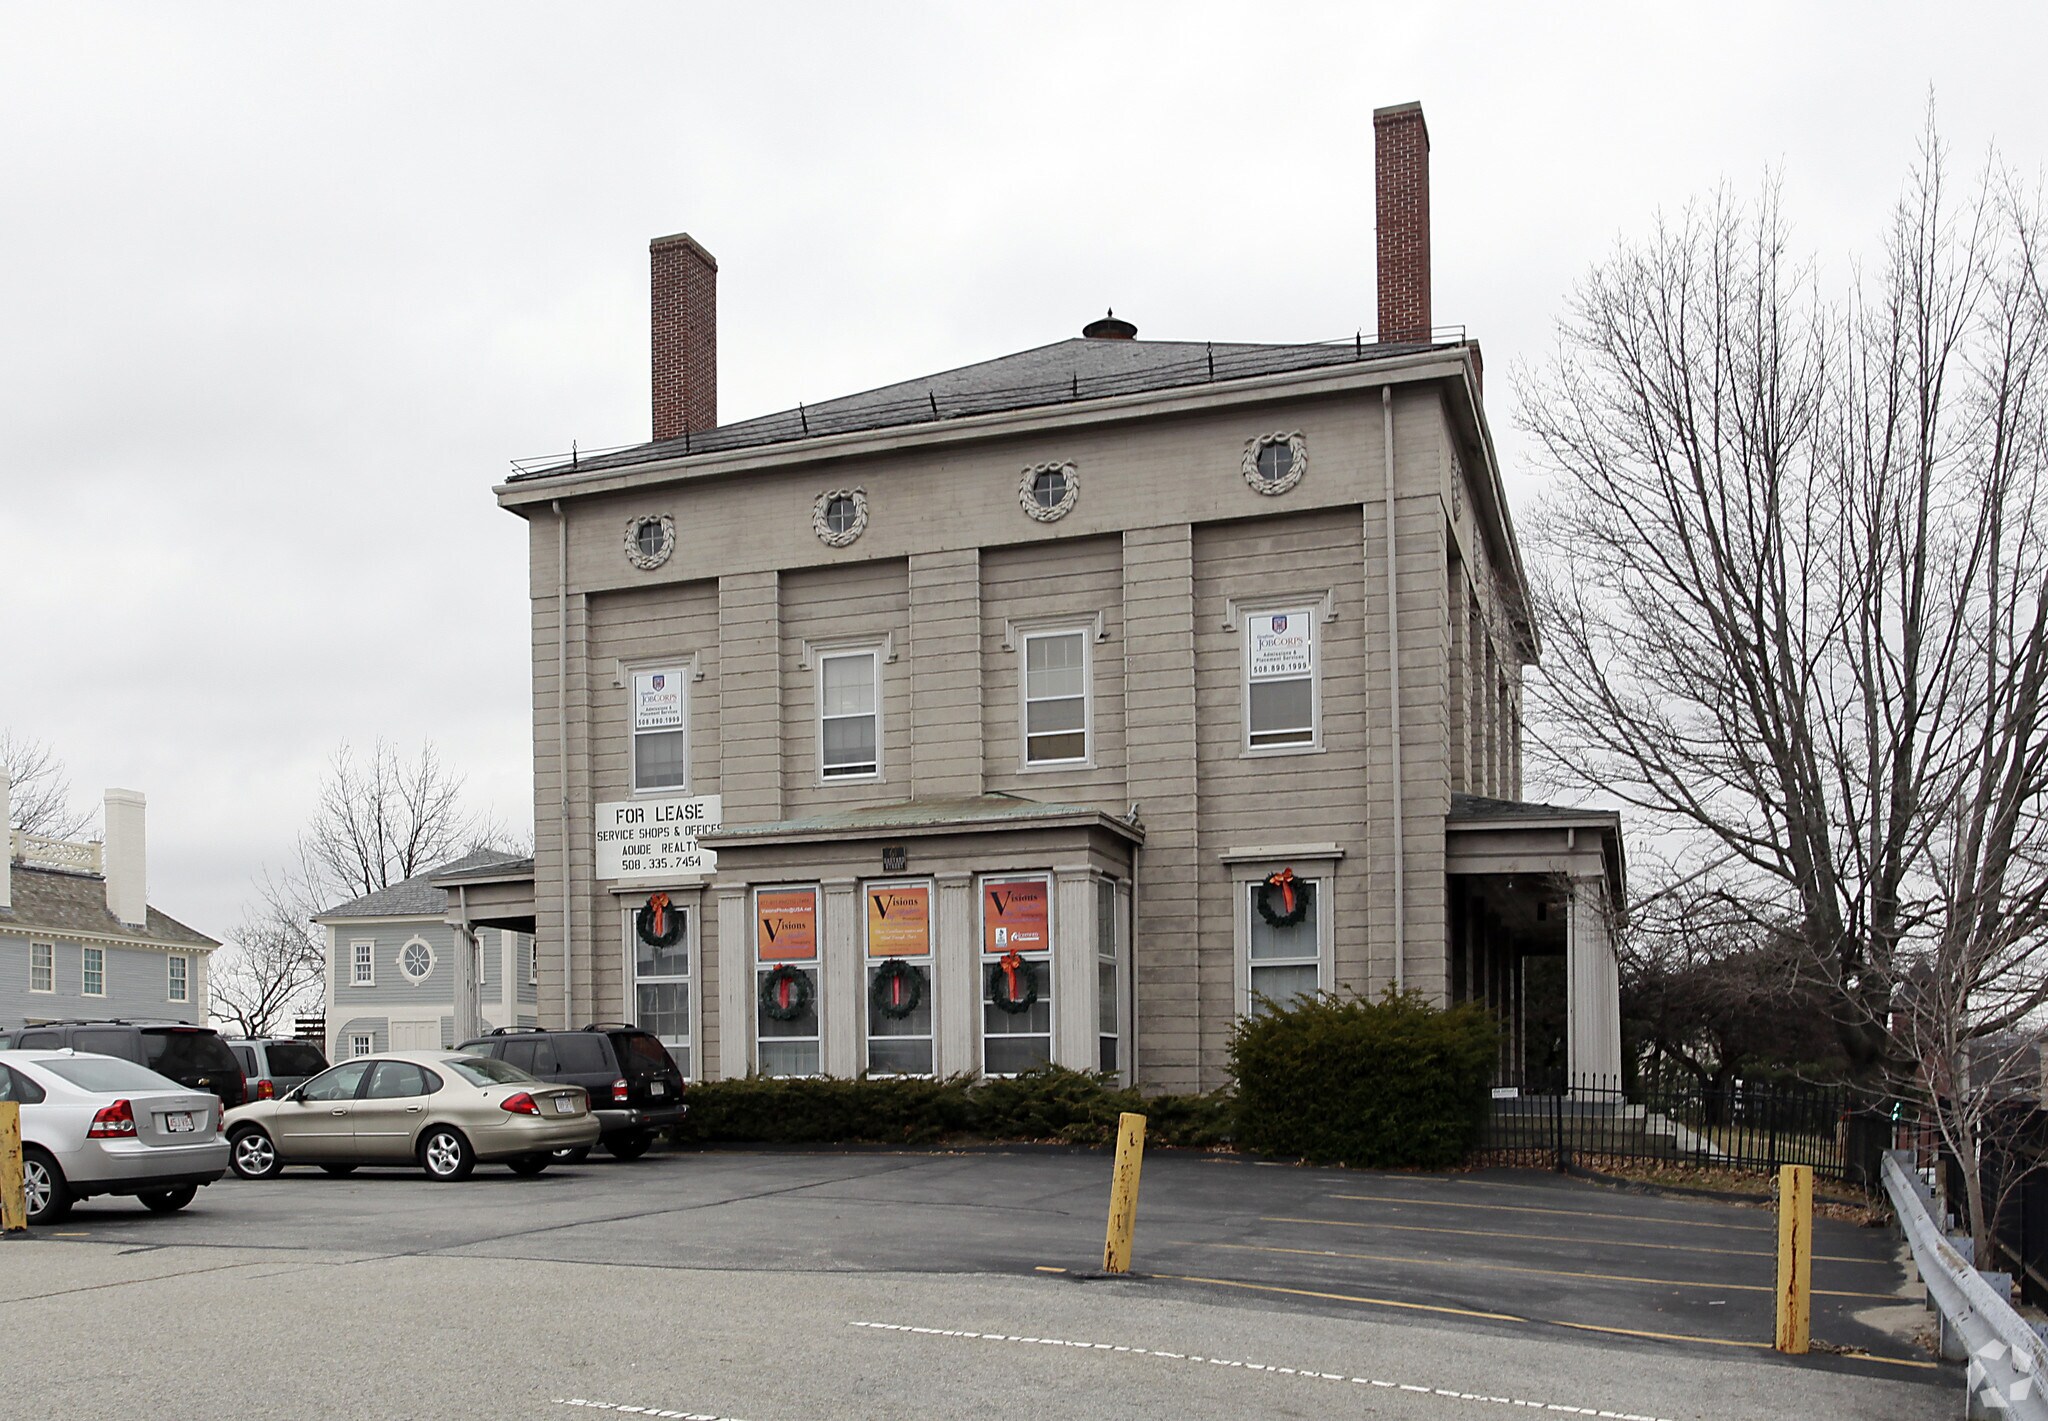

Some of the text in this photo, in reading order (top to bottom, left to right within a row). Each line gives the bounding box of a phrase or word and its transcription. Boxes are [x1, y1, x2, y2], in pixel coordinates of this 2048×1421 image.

[1254, 662, 1307, 673] 508.890.1999
[616, 803, 704, 824] FOR LEASE
[597, 829, 634, 841] SERVICE
[639, 827, 670, 839] SHOPS
[674, 826, 680, 837] &
[622, 841, 699, 856] AOUDE REALTY
[872, 894, 919, 920] Visions
[990, 890, 1038, 916] Visions
[763, 918, 806, 943] Visions
